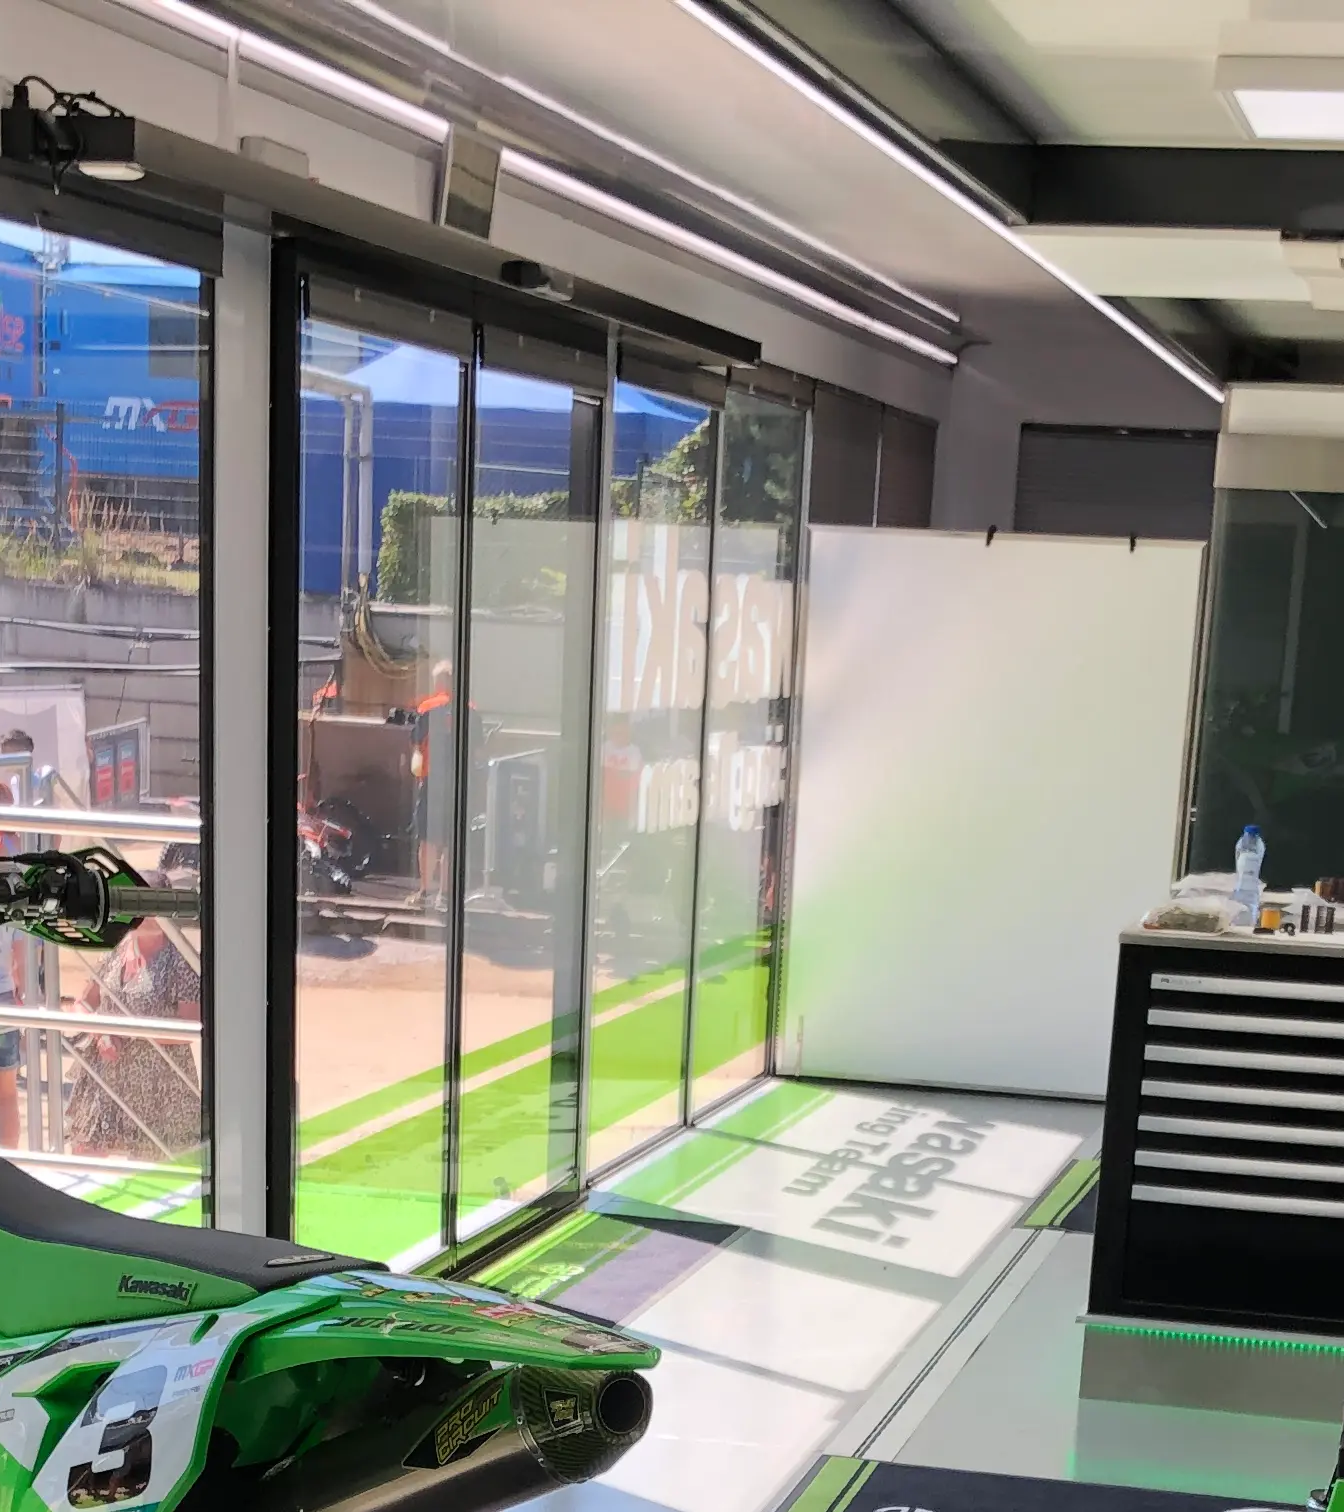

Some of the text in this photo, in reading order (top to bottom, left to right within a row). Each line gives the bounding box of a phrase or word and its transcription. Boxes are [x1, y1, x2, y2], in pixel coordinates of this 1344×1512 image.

[119, 1274, 192, 1301] Kawasaki
[173, 1358, 216, 1382] MXGP
[66, 1365, 168, 1509] 3
[437, 1401, 474, 1445] PRO
[438, 1388, 502, 1462] CIRCUIT
